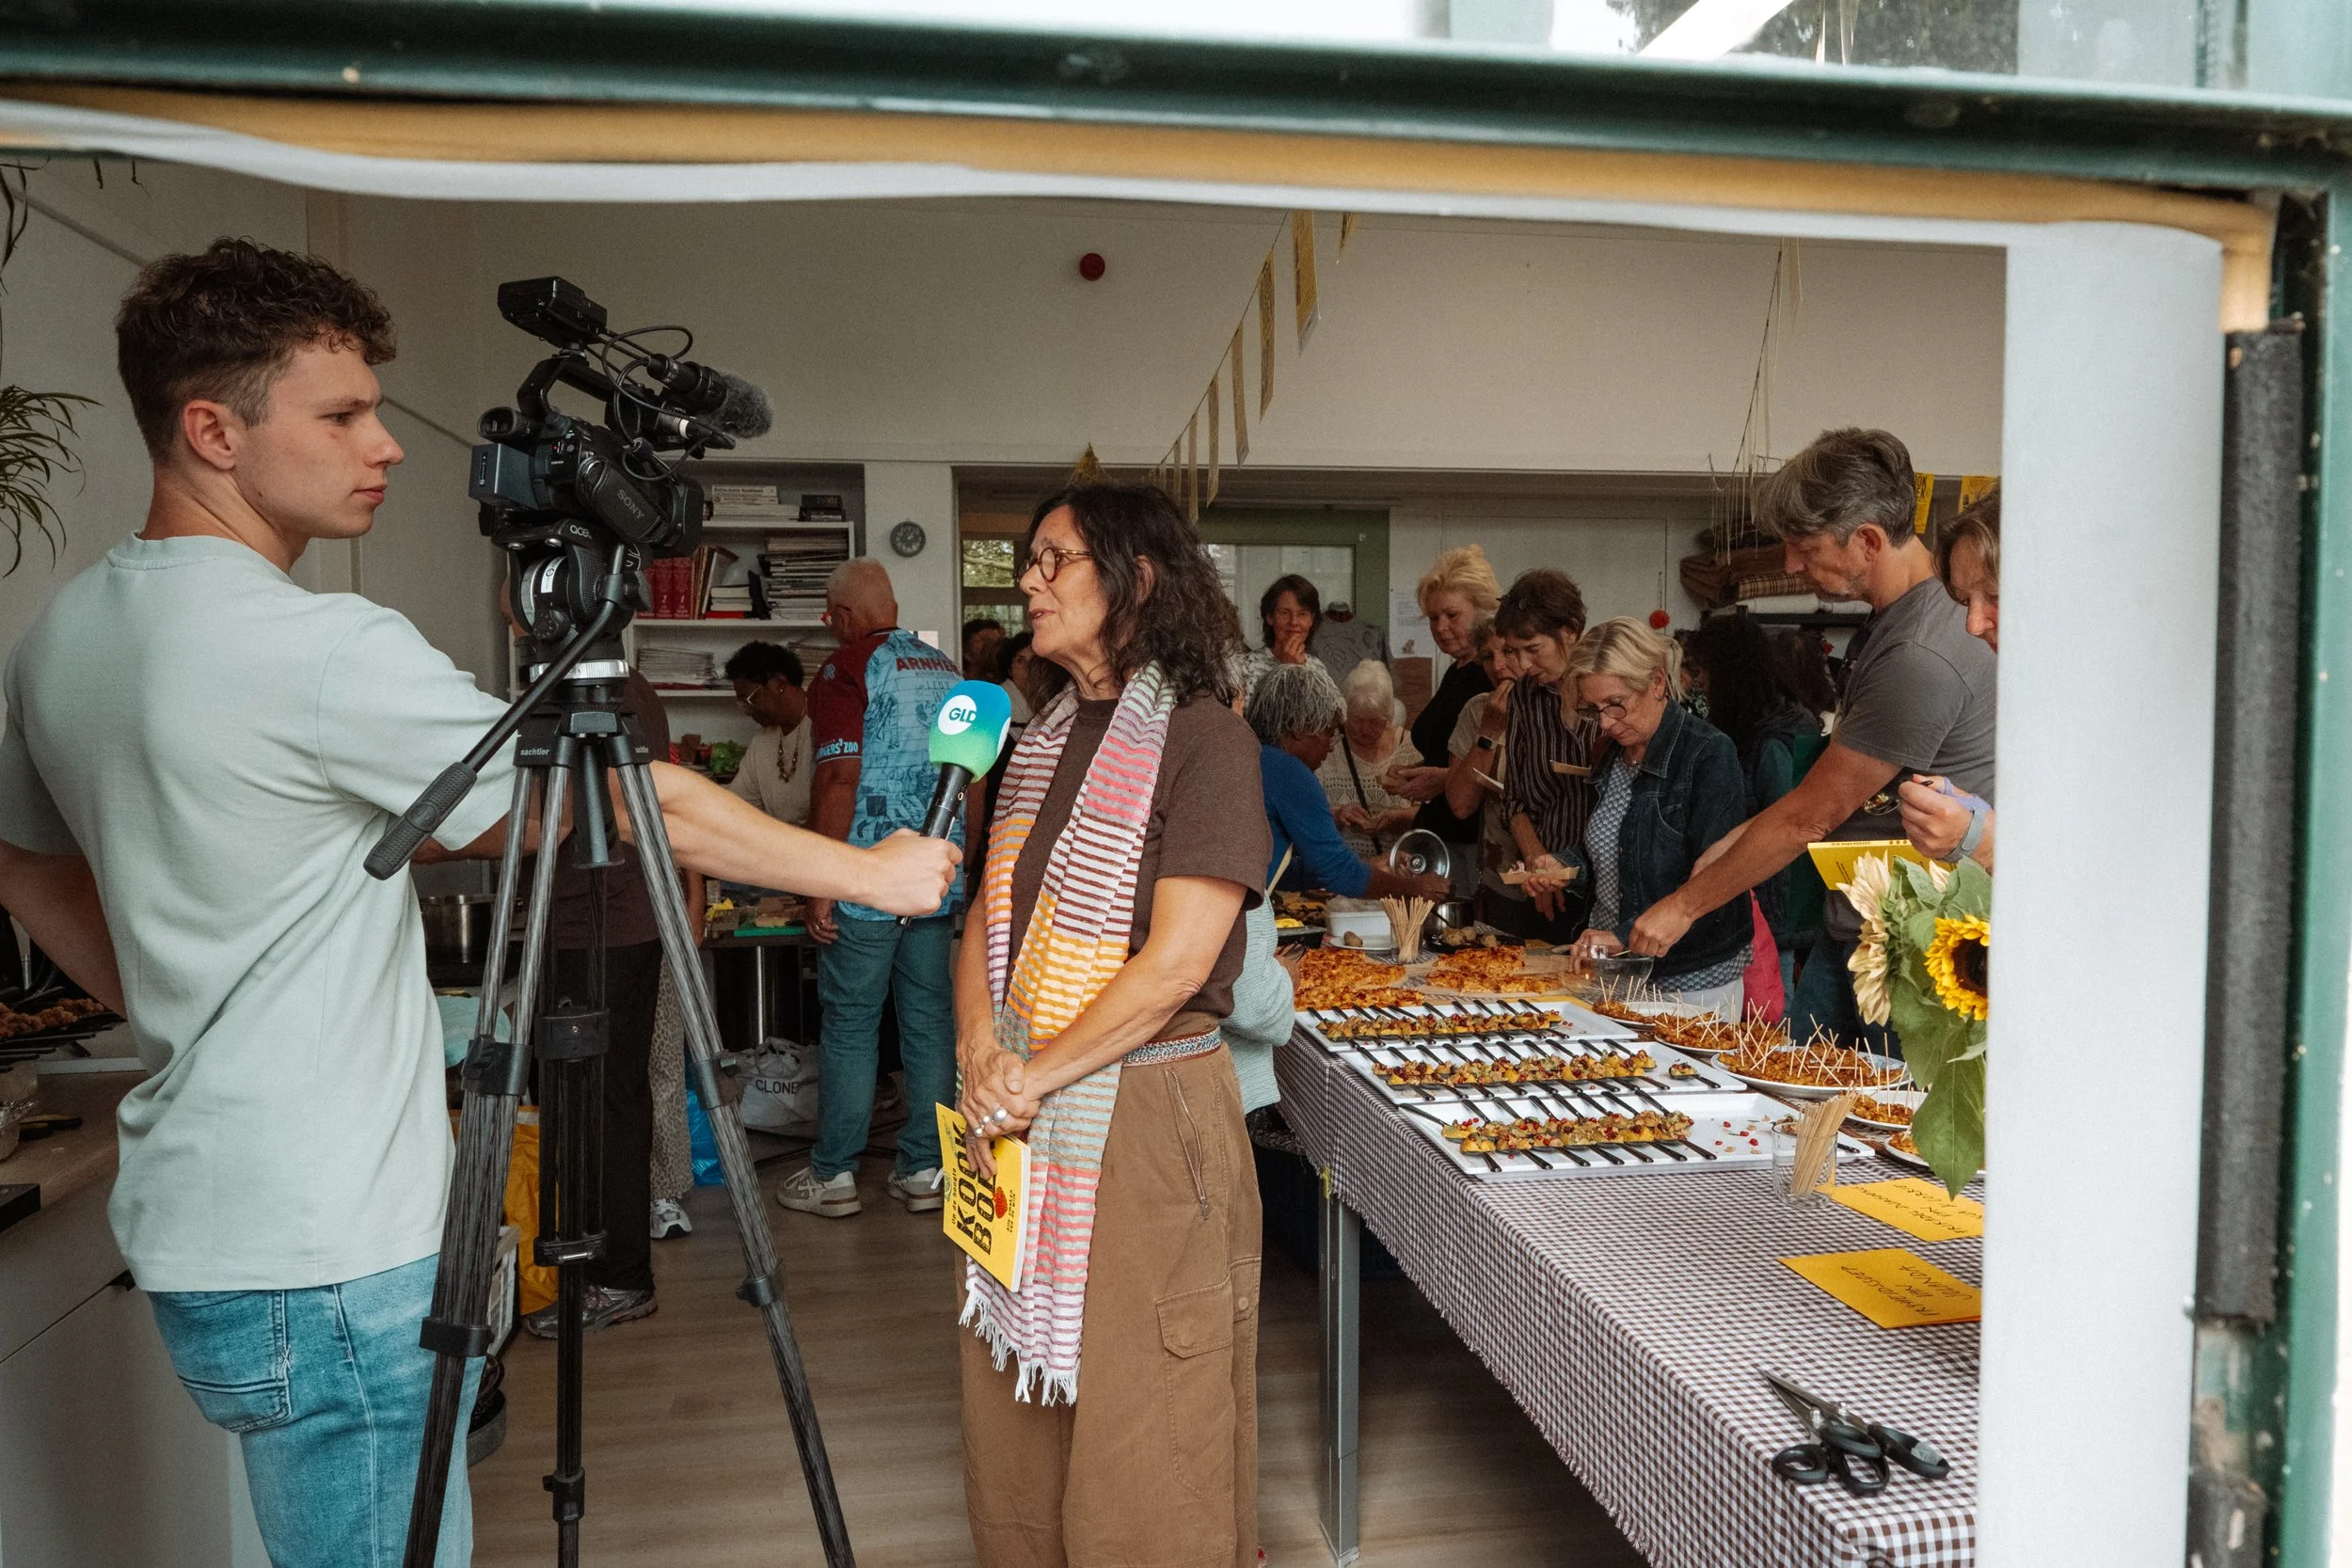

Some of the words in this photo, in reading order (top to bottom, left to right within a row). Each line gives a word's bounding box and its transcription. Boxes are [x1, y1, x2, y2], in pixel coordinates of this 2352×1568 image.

[616, 488, 645, 520] SONY
[569, 524, 590, 538] ace
[948, 706, 977, 724] GLD
[520, 748, 549, 756] sachtler
[843, 741, 858, 752] ZOO
[1899, 1265, 1973, 1300] JOLANDA
